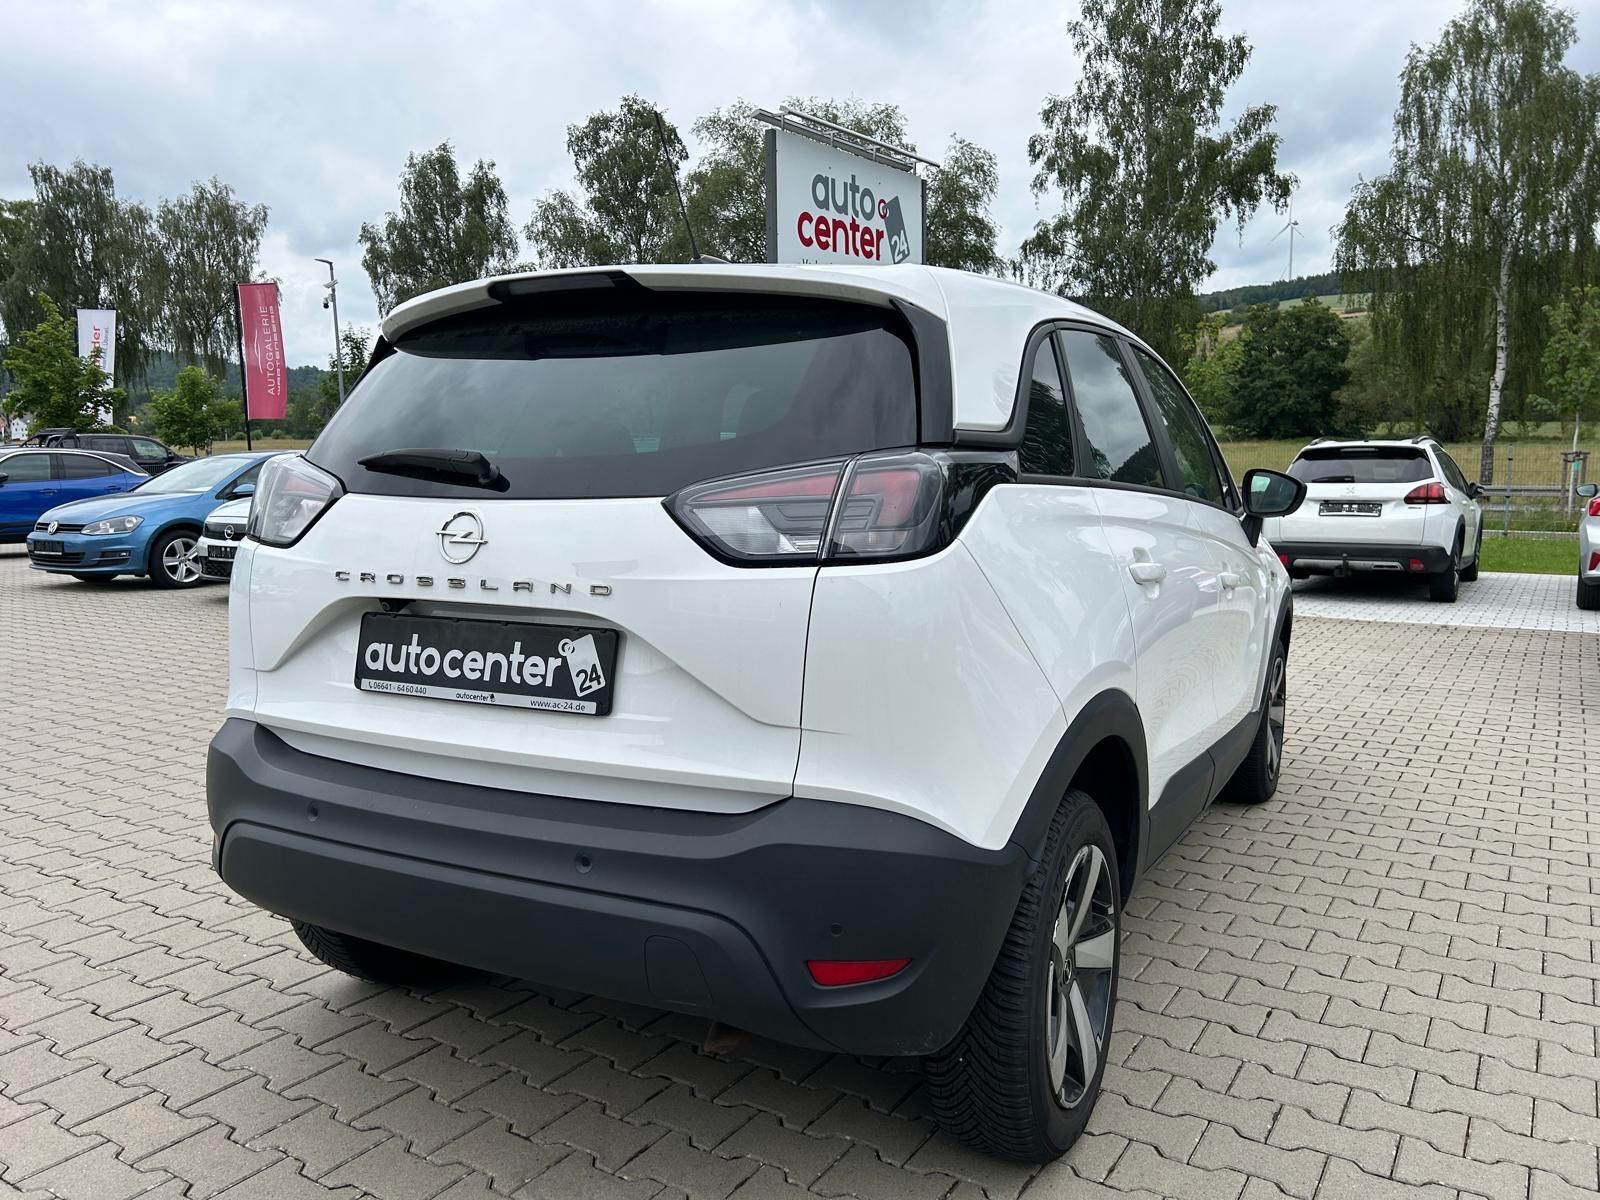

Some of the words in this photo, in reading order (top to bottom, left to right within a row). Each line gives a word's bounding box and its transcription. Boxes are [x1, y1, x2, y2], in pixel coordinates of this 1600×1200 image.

[811, 174, 876, 221] auto
[797, 211, 885, 261] center
[891, 229, 909, 262] 24
[260, 305, 276, 396] AUTOGALERIE
[335, 571, 613, 596] CROSSLAND
[575, 663, 602, 693] 24
[530, 699, 586, 712] www.ac-24.de
